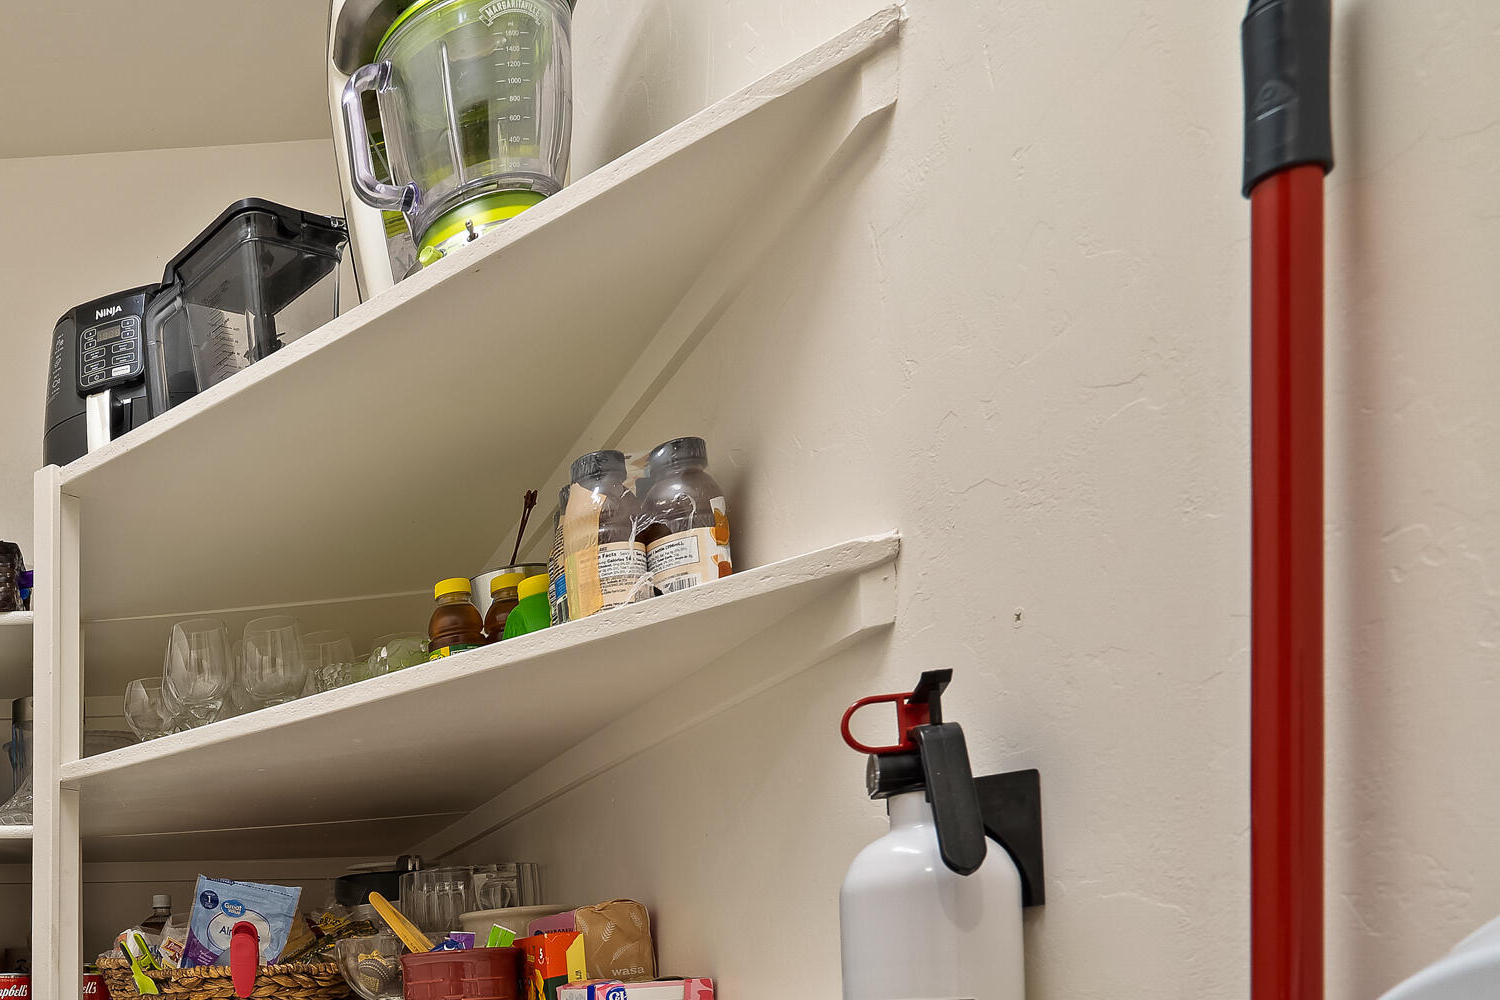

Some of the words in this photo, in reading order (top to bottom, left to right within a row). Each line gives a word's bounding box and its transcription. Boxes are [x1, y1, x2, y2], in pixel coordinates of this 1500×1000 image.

[485, 0, 540, 16] MARGARITAVILLE
[95, 305, 122, 320] NINJA
[224, 901, 242, 910] Great
[611, 966, 645, 977] wasa
